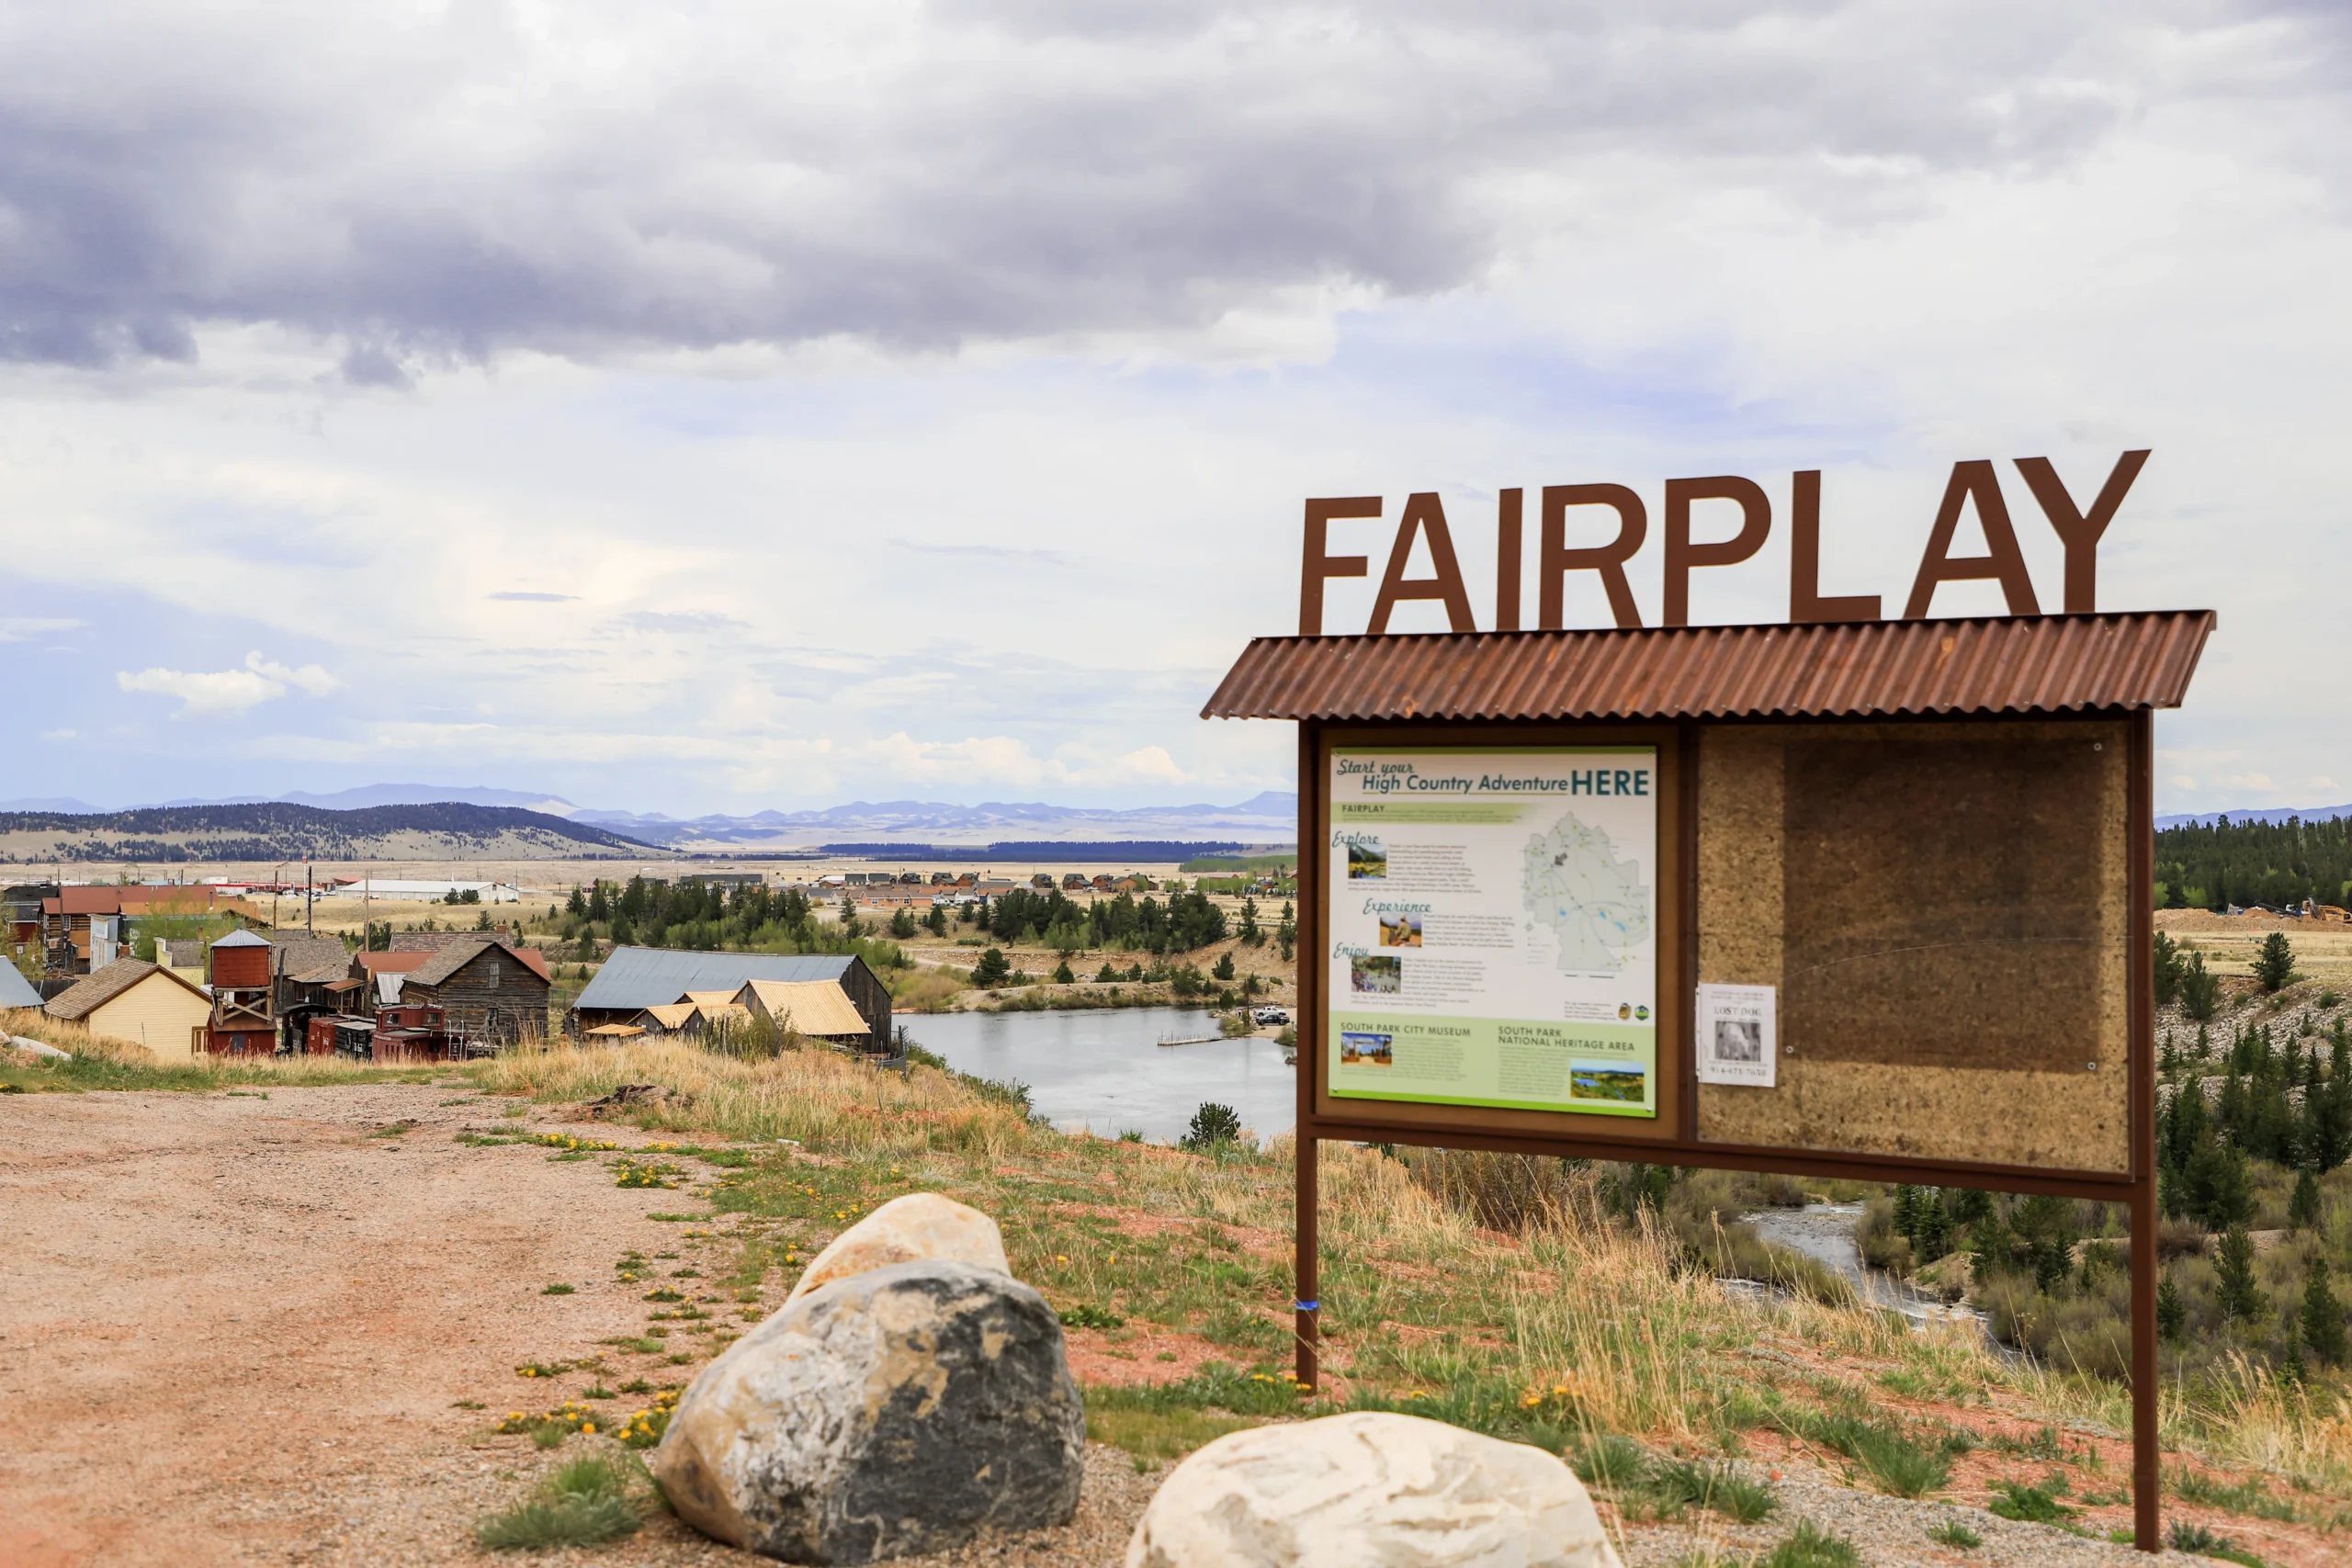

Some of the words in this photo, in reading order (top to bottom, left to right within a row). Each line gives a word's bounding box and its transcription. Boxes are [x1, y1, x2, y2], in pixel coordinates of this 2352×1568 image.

[1298, 449, 2153, 637] FAIRPLAY
[1337, 759, 1375, 775] Start
[1381, 762, 1414, 777] your
[1363, 774, 1400, 795] High
[1407, 774, 1473, 795] Country
[1478, 774, 1568, 791] Adventure
[1571, 770, 1649, 795] HERE
[1342, 805, 1385, 813] FAIRPLAY
[1332, 830, 1380, 848] Explore
[1363, 897, 1433, 915] Experience
[1333, 942, 1369, 959] Enjoy
[1340, 1022, 1374, 1032] SOUTH
[1376, 1024, 1400, 1033] PARK
[1404, 1025, 1424, 1034] CITY
[1428, 1027, 1471, 1036] MUSEUM
[1498, 1026, 1532, 1035] SOUTH
[1537, 1028, 1562, 1037] PARK
[1498, 1036, 1551, 1046] NATIONAL
[1555, 1039, 1604, 1050] HERITAGE
[1608, 1041, 1635, 1051] AREA
